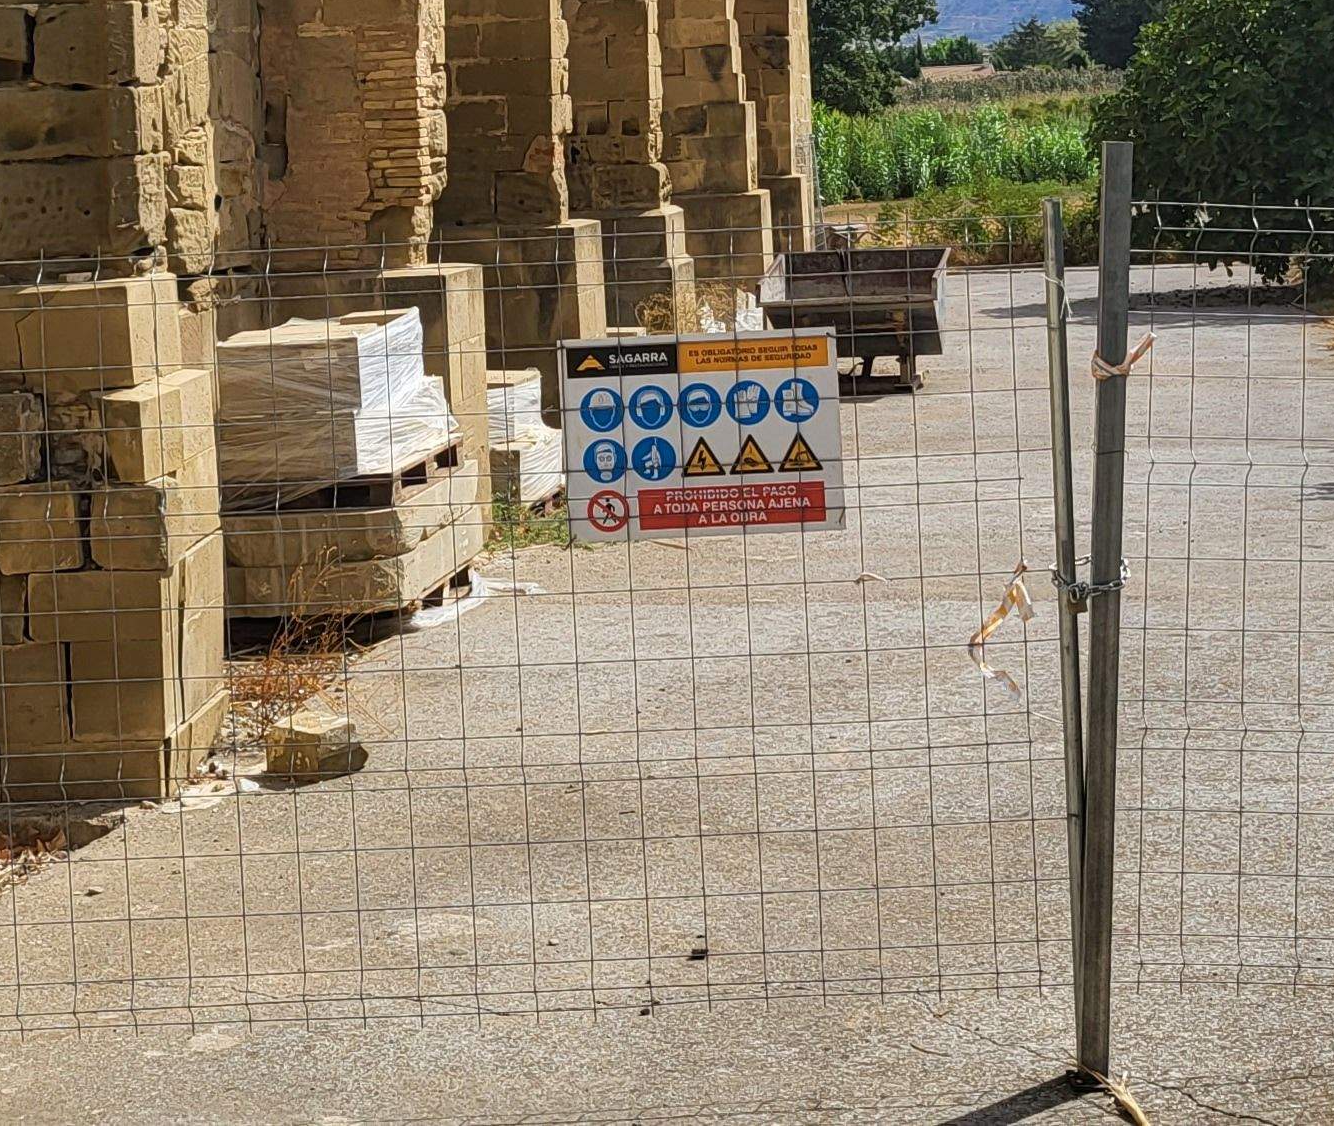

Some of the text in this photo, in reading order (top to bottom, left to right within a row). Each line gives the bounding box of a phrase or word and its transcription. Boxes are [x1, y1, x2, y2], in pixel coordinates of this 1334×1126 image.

[608, 352, 668, 364] SAGARRA
[666, 485, 796, 501] PROHIBIDO EL PASO
[653, 497, 811, 514] A TODA PERSONA AJENA
[698, 513, 707, 524] A
[711, 513, 727, 524] LA
